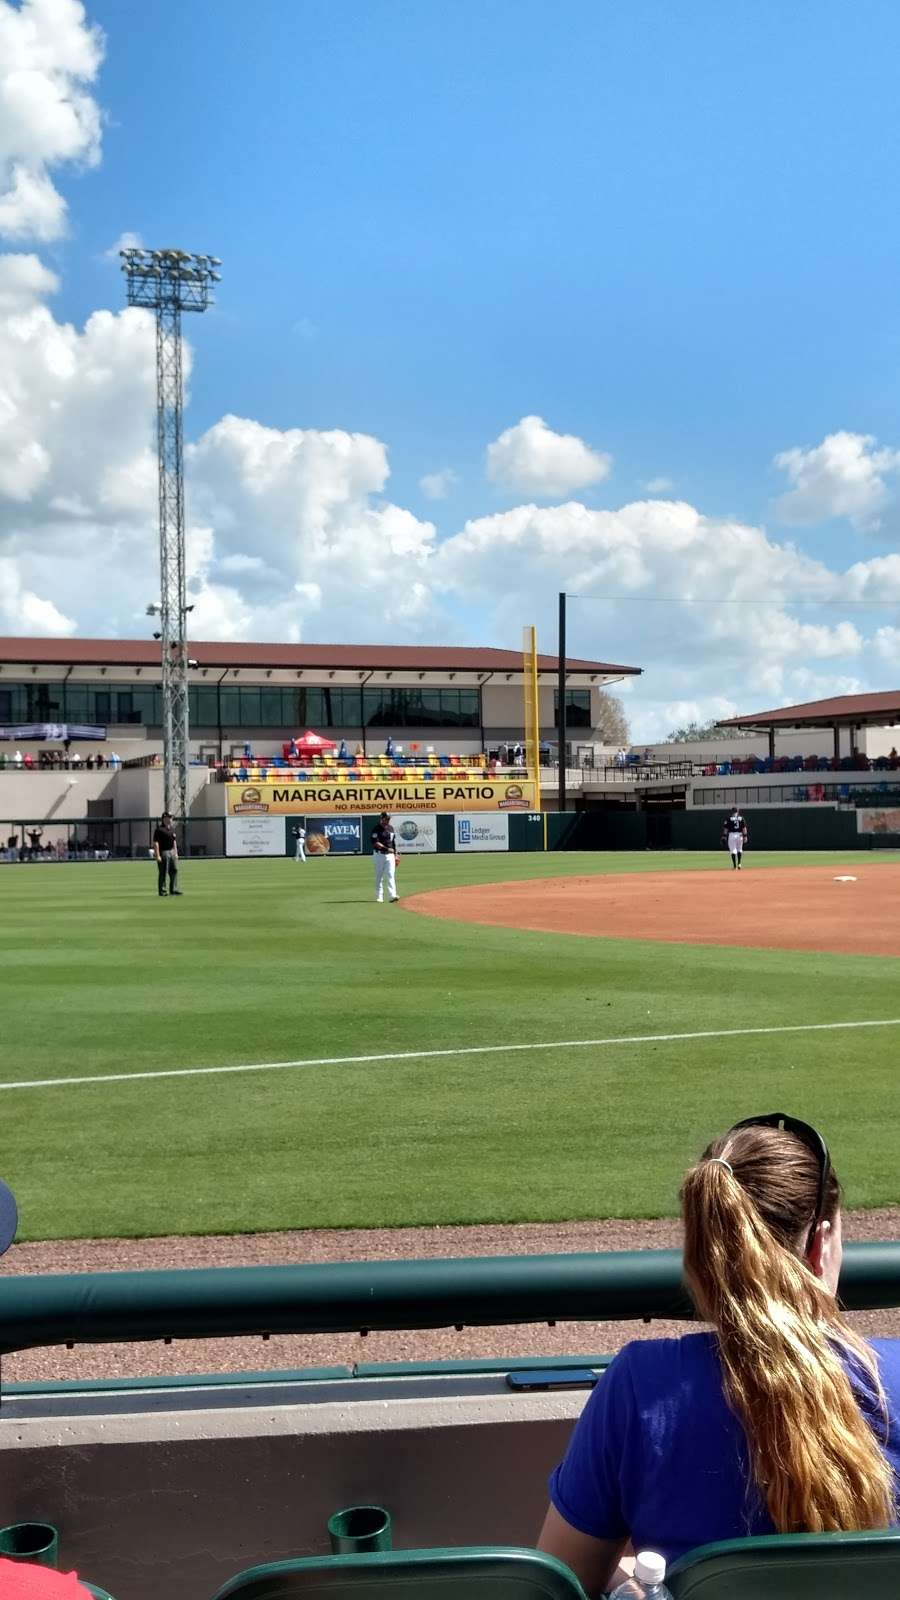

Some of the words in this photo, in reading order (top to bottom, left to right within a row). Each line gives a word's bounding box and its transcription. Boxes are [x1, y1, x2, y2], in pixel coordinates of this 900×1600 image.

[273, 788, 436, 802] MARGARITAVILLE
[443, 787, 494, 800] PATIO
[324, 824, 361, 839] KAYEM
[471, 827, 490, 835] Ledger
[471, 833, 488, 841] Media
[489, 834, 506, 842] Group
